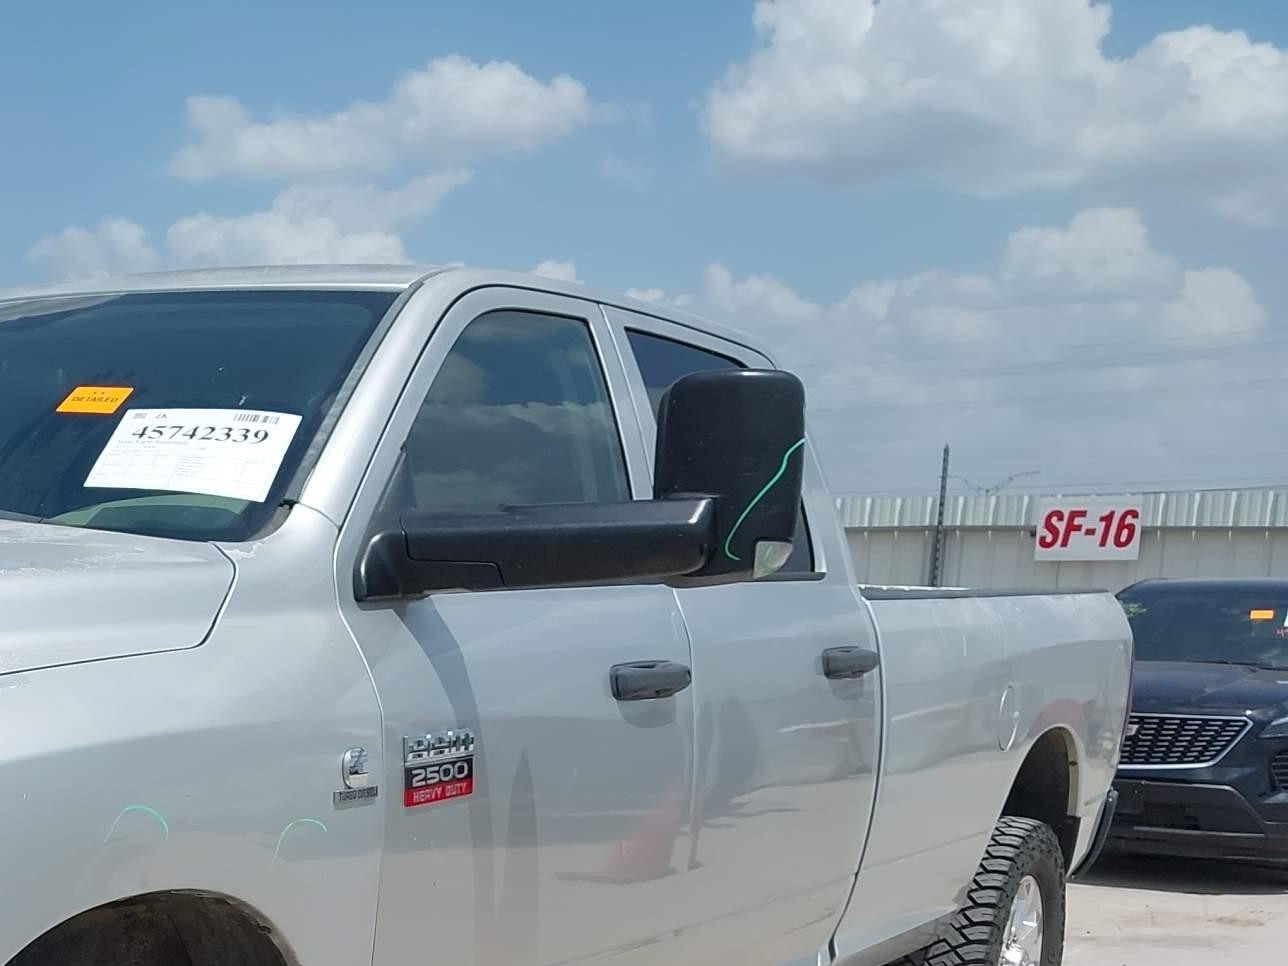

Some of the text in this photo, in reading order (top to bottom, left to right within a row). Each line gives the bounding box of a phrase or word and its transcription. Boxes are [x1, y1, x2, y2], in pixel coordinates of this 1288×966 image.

[131, 425, 269, 444] 45742339
[1038, 509, 1140, 549] SF-16
[412, 761, 469, 787] 2500
[413, 782, 468, 803] HEAVY DUTY
